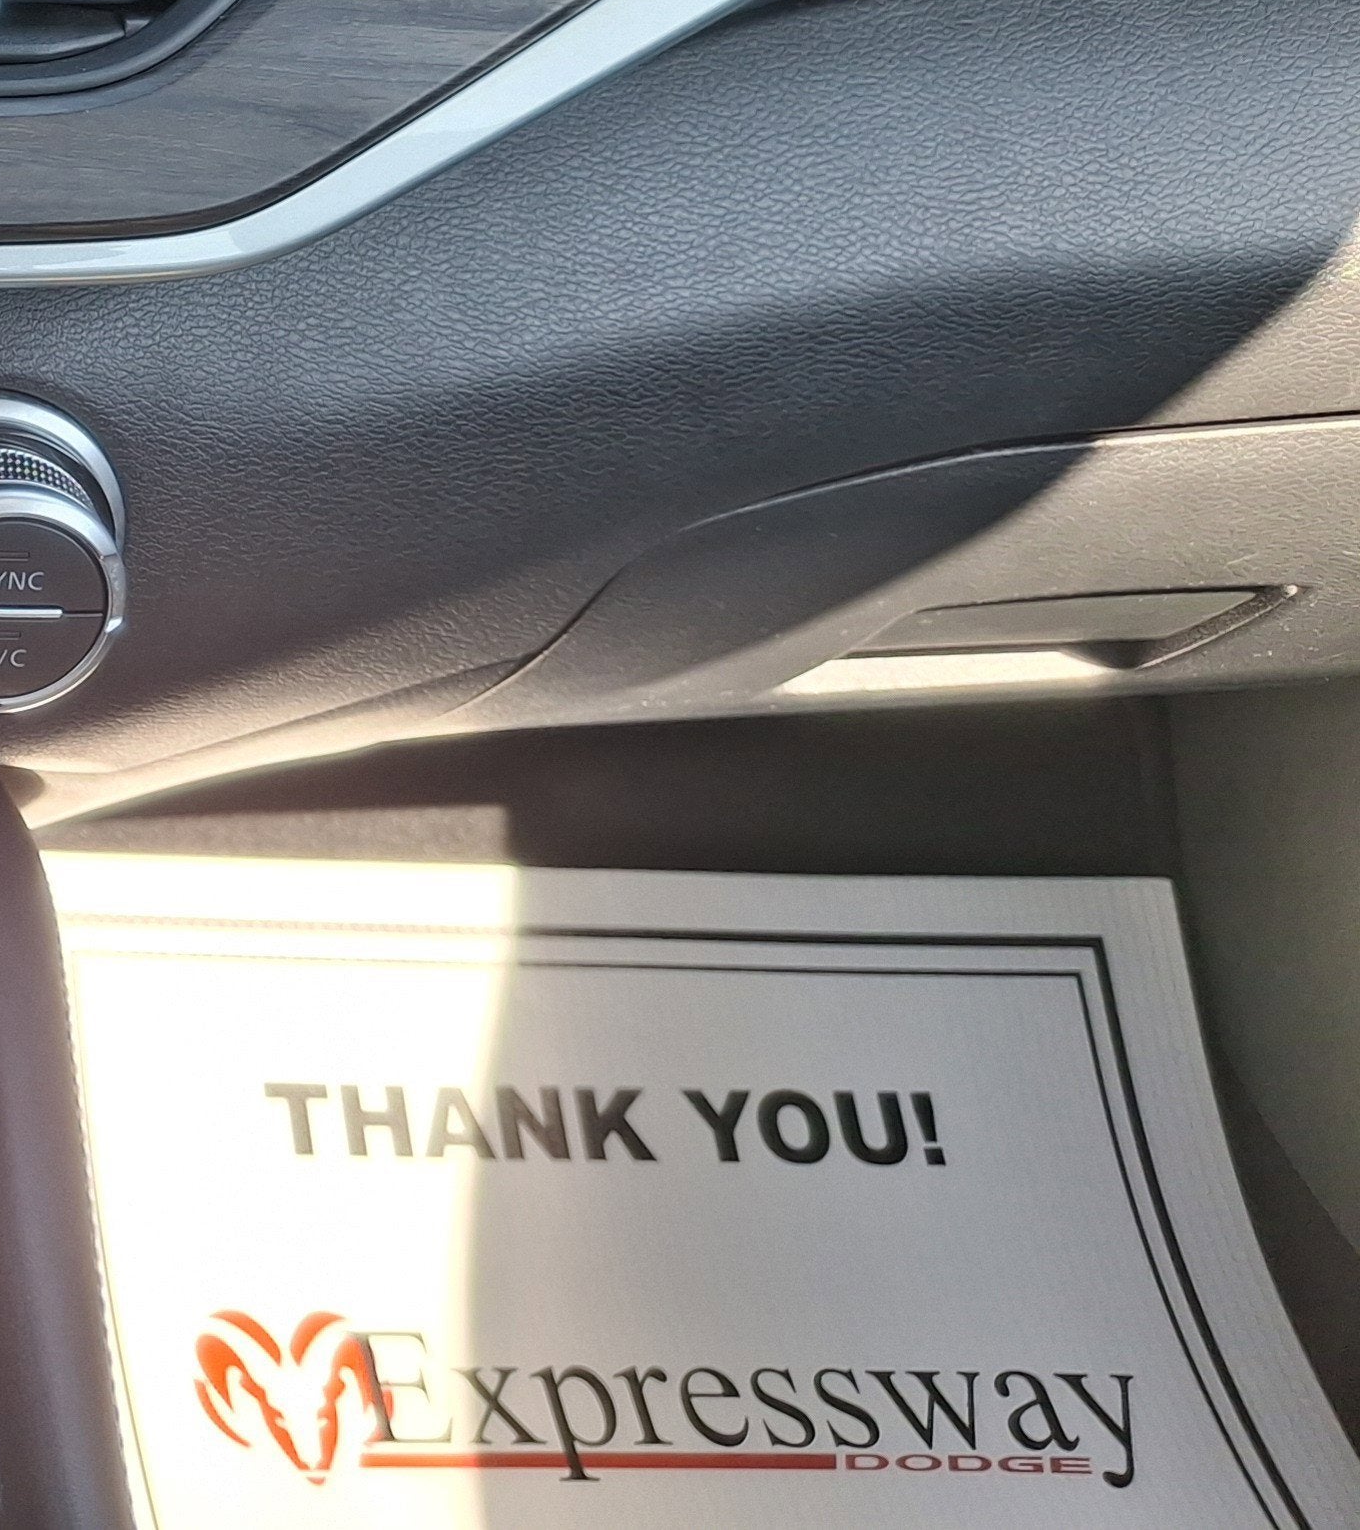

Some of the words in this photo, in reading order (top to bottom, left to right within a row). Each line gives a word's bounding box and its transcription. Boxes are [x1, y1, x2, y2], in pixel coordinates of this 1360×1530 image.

[262, 1081, 657, 1163] THANK
[681, 1088, 948, 1168] YOU!
[346, 1328, 1137, 1488] Expressway
[845, 1453, 1093, 1474] DODGE
